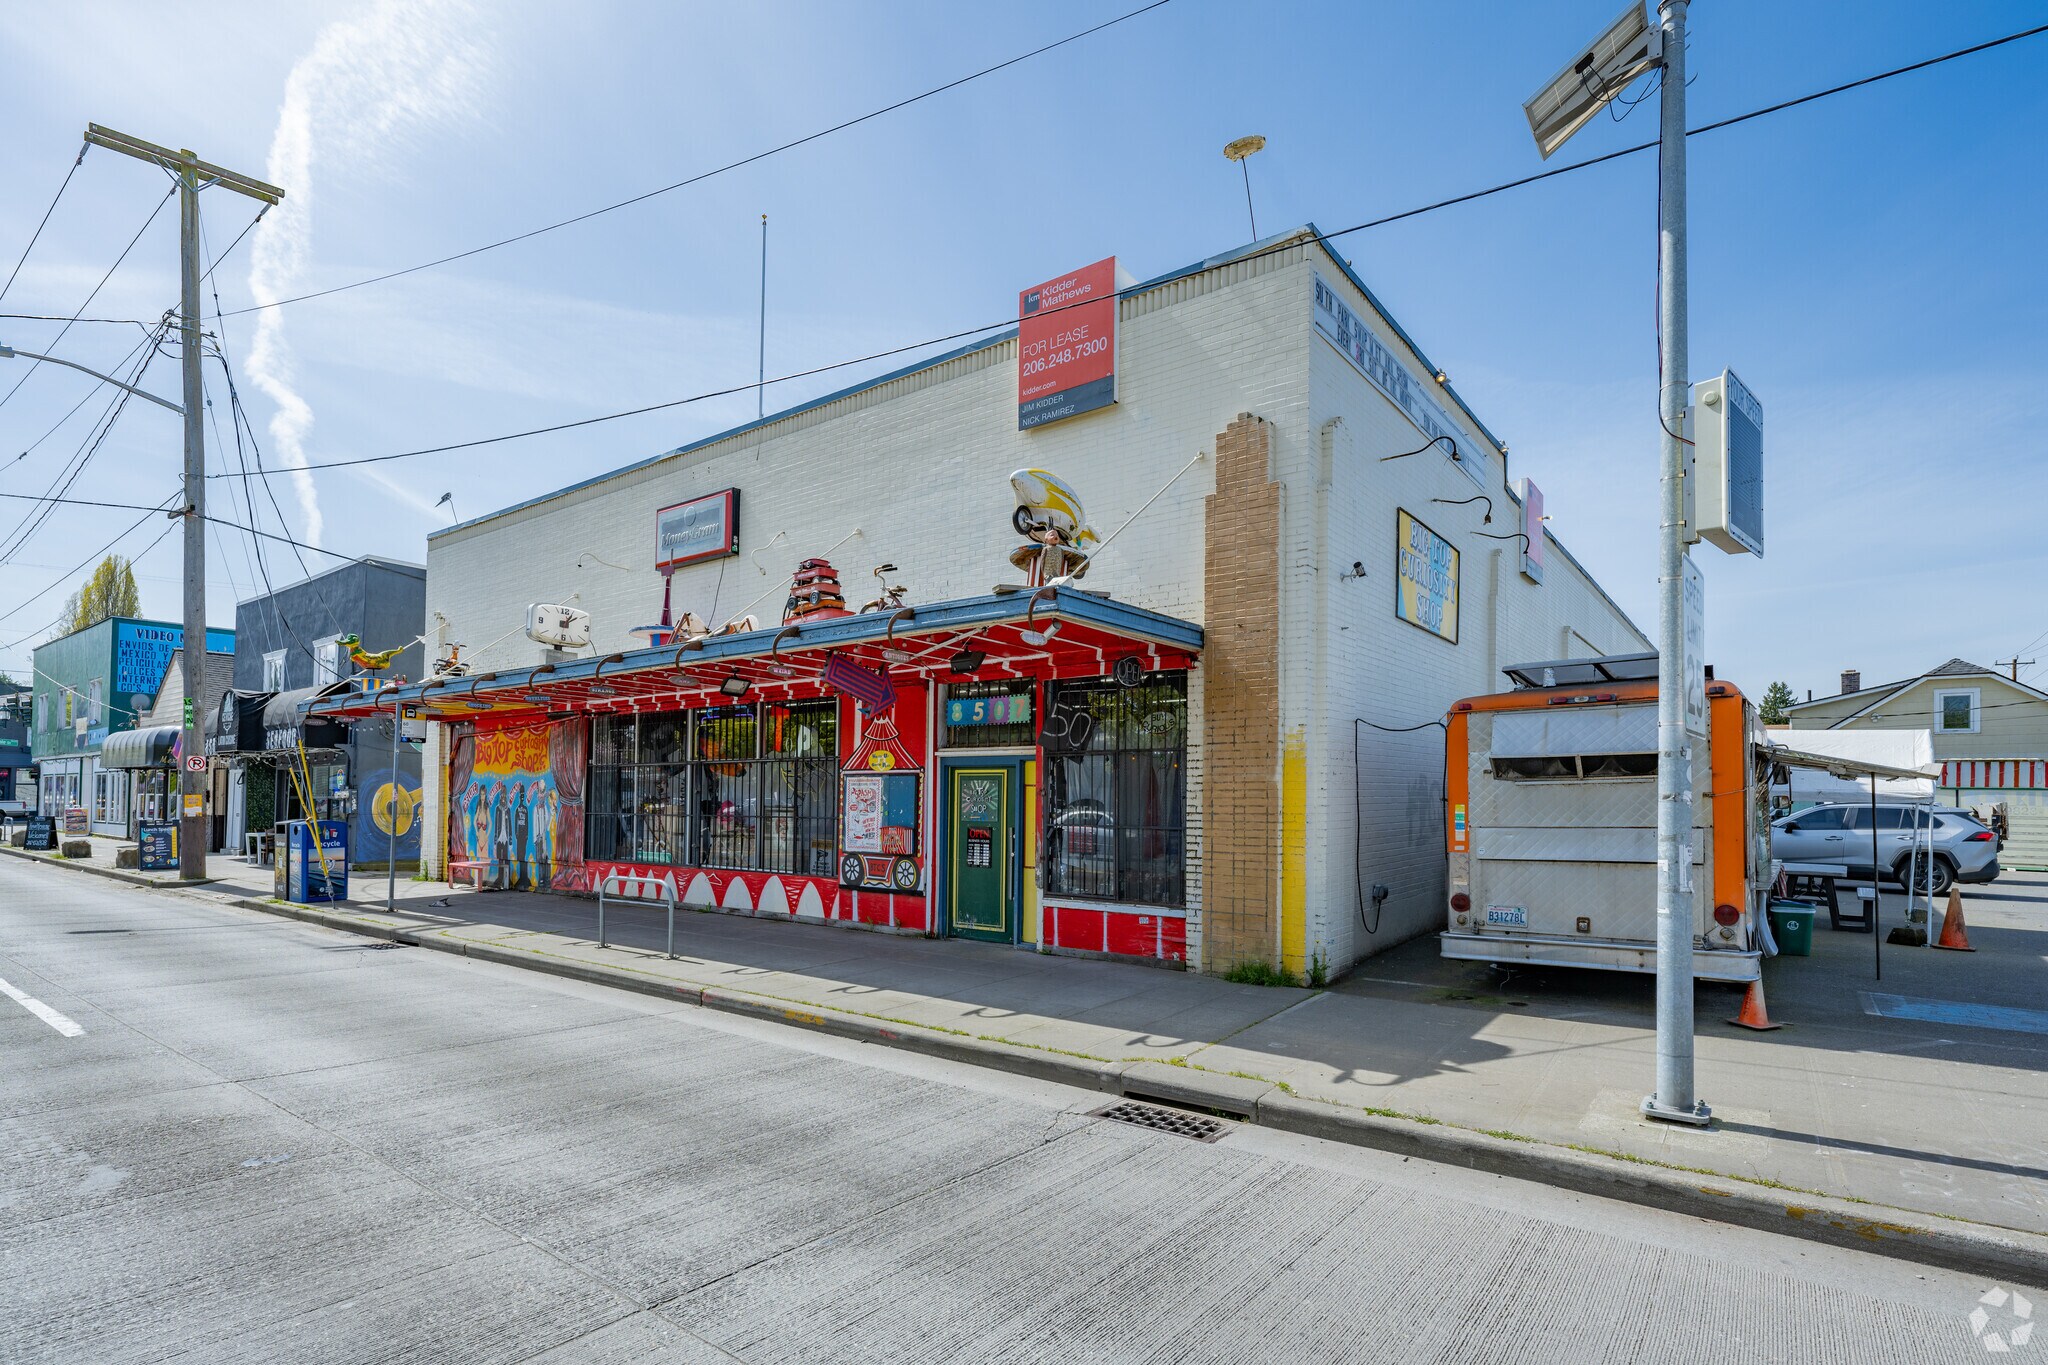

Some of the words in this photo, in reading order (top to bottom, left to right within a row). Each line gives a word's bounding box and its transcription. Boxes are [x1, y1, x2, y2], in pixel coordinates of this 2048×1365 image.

[1042, 279, 1077, 299] Kidder
[1042, 283, 1092, 309] Mathews
[1023, 340, 1047, 359] FOR
[1050, 325, 1090, 350] LEASE
[1023, 336, 1108, 377] 206.248.7300
[1022, 379, 1057, 396] kidder.com
[1022, 402, 1035, 414] JIM
[1036, 394, 1065, 410] KIDDER
[1022, 414, 1040, 427] NICK
[1041, 404, 1075, 421] RAMIREZ
[660, 522, 719, 548] MoneyGram
[1410, 520, 1429, 558] BIG
[1433, 538, 1452, 571] TOP
[1400, 547, 1456, 605] CURIOSITY
[1685, 577, 1702, 616] SPEED
[1416, 592, 1443, 631] SHOP
[136, 628, 174, 642] VIDEO
[561, 634, 566, 642] 6
[1687, 615, 1701, 649] LIMIT
[119, 640, 153, 651] ENVIOS
[158, 643, 170, 652] DE
[121, 649, 156, 659] MEXICO
[163, 652, 169, 661] Y
[119, 657, 168, 669] PELICULAS
[121, 665, 155, 676] DULCES
[1687, 653, 1704, 719] 25
[969, 829, 990, 838] OPEN
